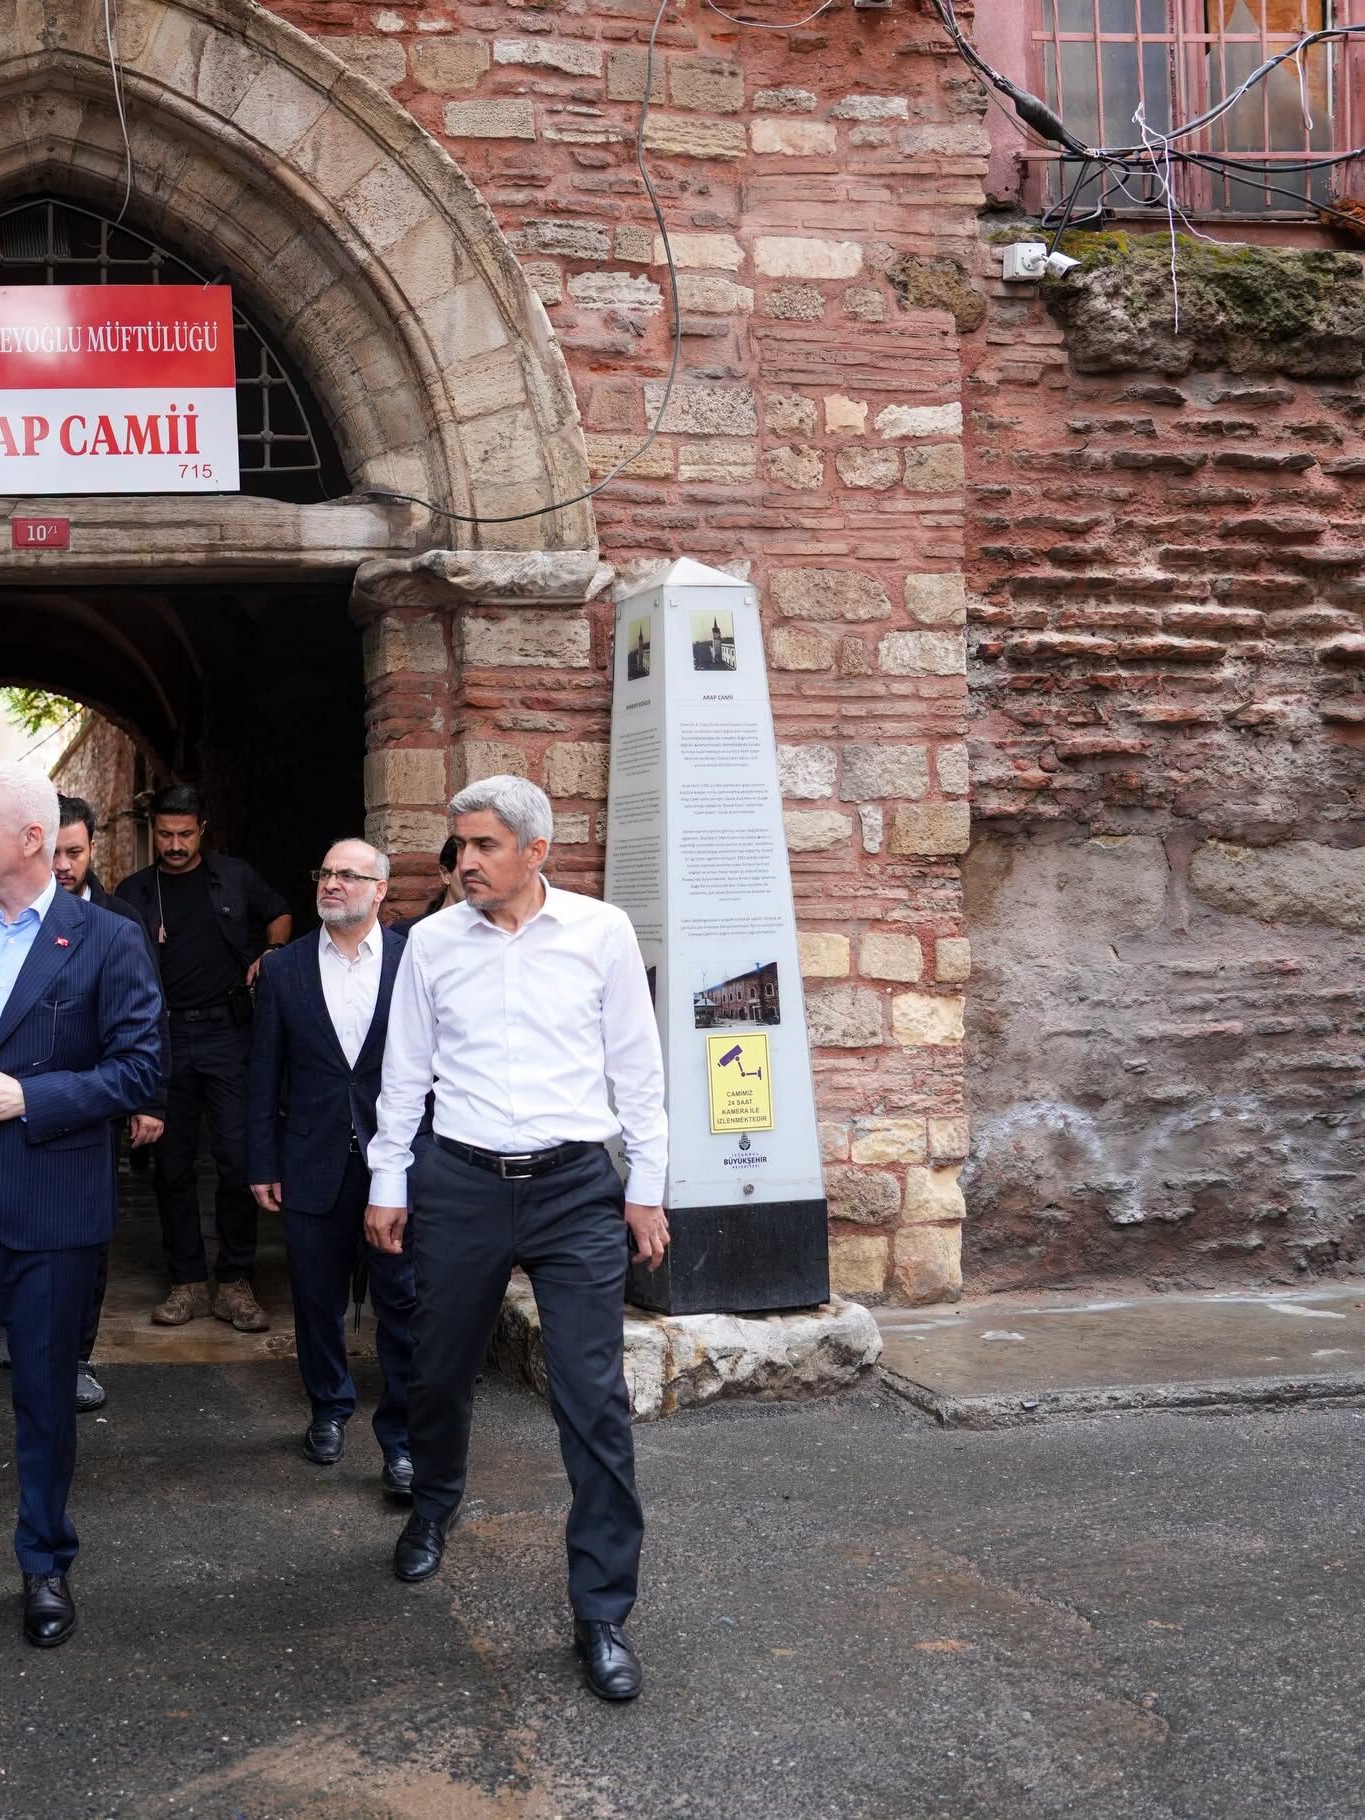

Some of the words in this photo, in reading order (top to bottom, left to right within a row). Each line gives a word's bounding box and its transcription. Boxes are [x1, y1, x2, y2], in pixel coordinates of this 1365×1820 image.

[87, 320, 218, 352] MÜFTÜLÜĞÜ
[59, 403, 200, 456] CAMİİ
[178, 464, 213, 479] 715
